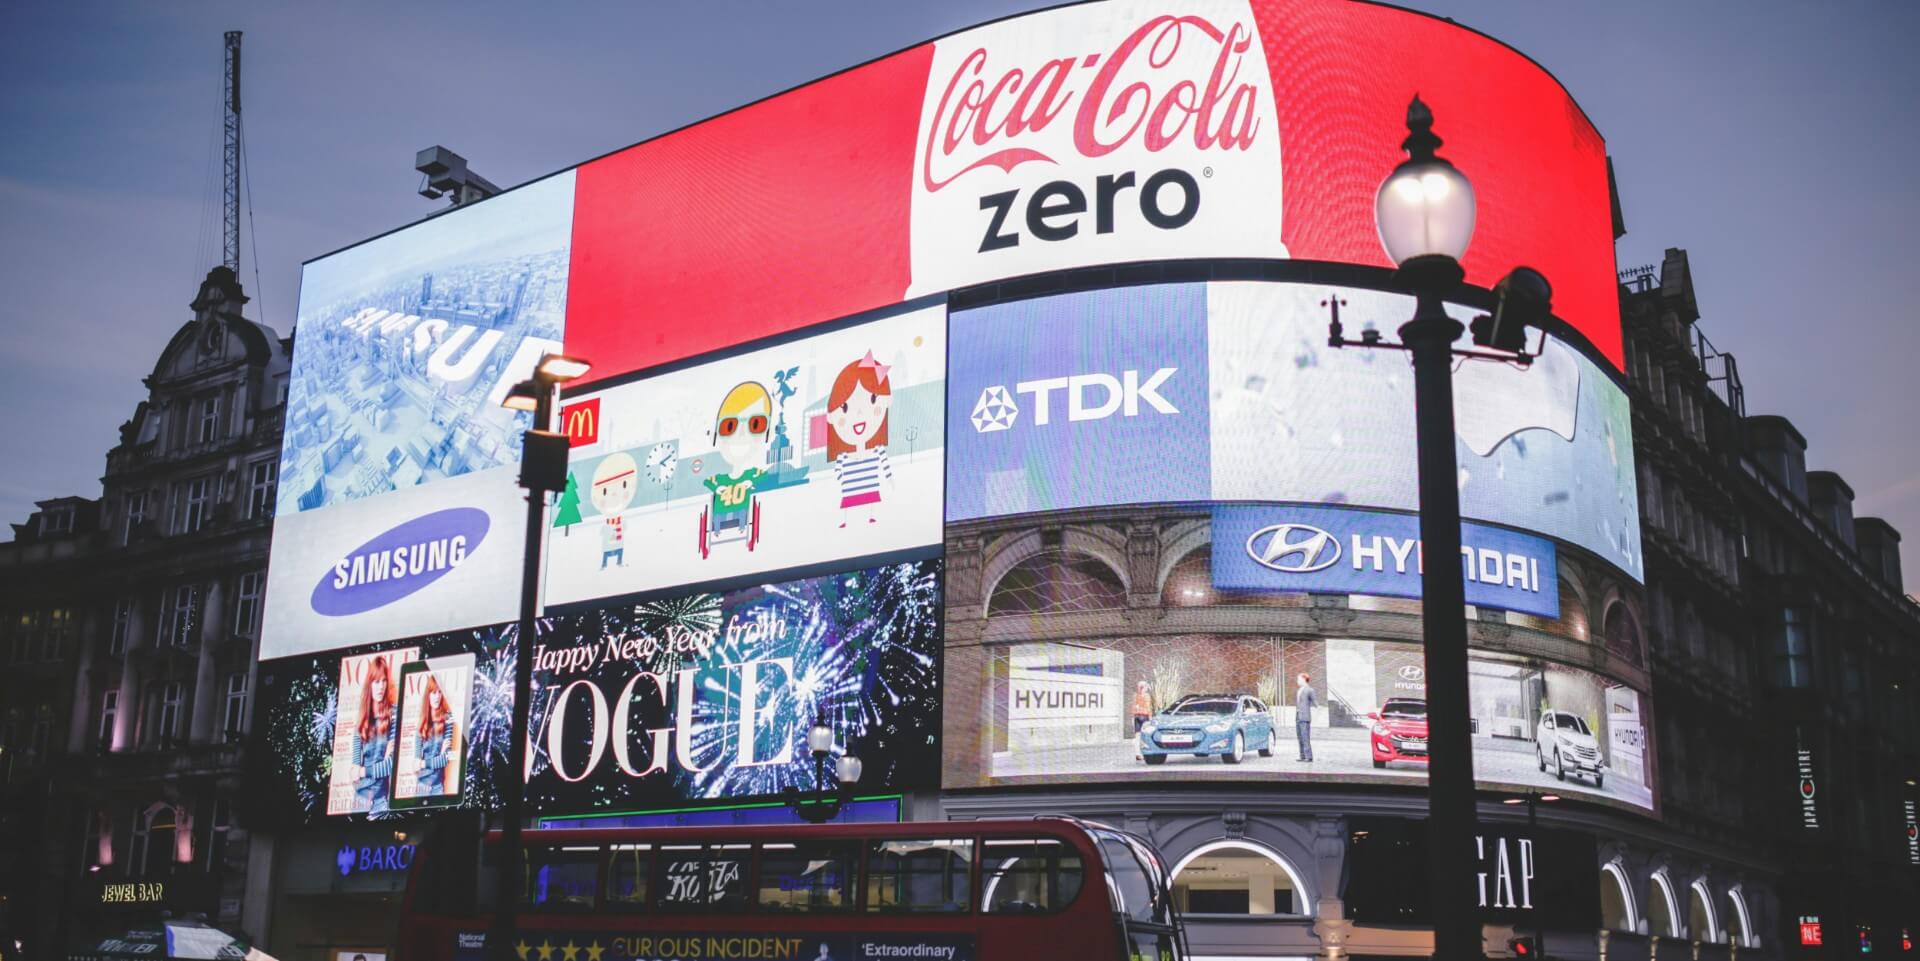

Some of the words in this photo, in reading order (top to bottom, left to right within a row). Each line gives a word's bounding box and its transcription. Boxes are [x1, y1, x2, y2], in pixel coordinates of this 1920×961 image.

[924, 15, 1260, 192] Coca-Cola
[978, 168, 1201, 253] zero
[1017, 367, 1181, 426] TDK
[720, 484, 747, 506] 40
[333, 535, 467, 589] SAMSUNG
[1351, 534, 1539, 592] HYNDAI
[602, 633, 657, 662] New
[665, 624, 720, 654] Year
[724, 614, 786, 654] from
[1016, 689, 1103, 709] HYUNDAI
[1798, 750, 1815, 799] CENTRE
[1803, 799, 1819, 828] JAPAN
[101, 884, 136, 902] JEWEL
[138, 882, 163, 901] BAR
[612, 937, 700, 958] CURIOUS
[706, 938, 803, 959] INCIDENT
